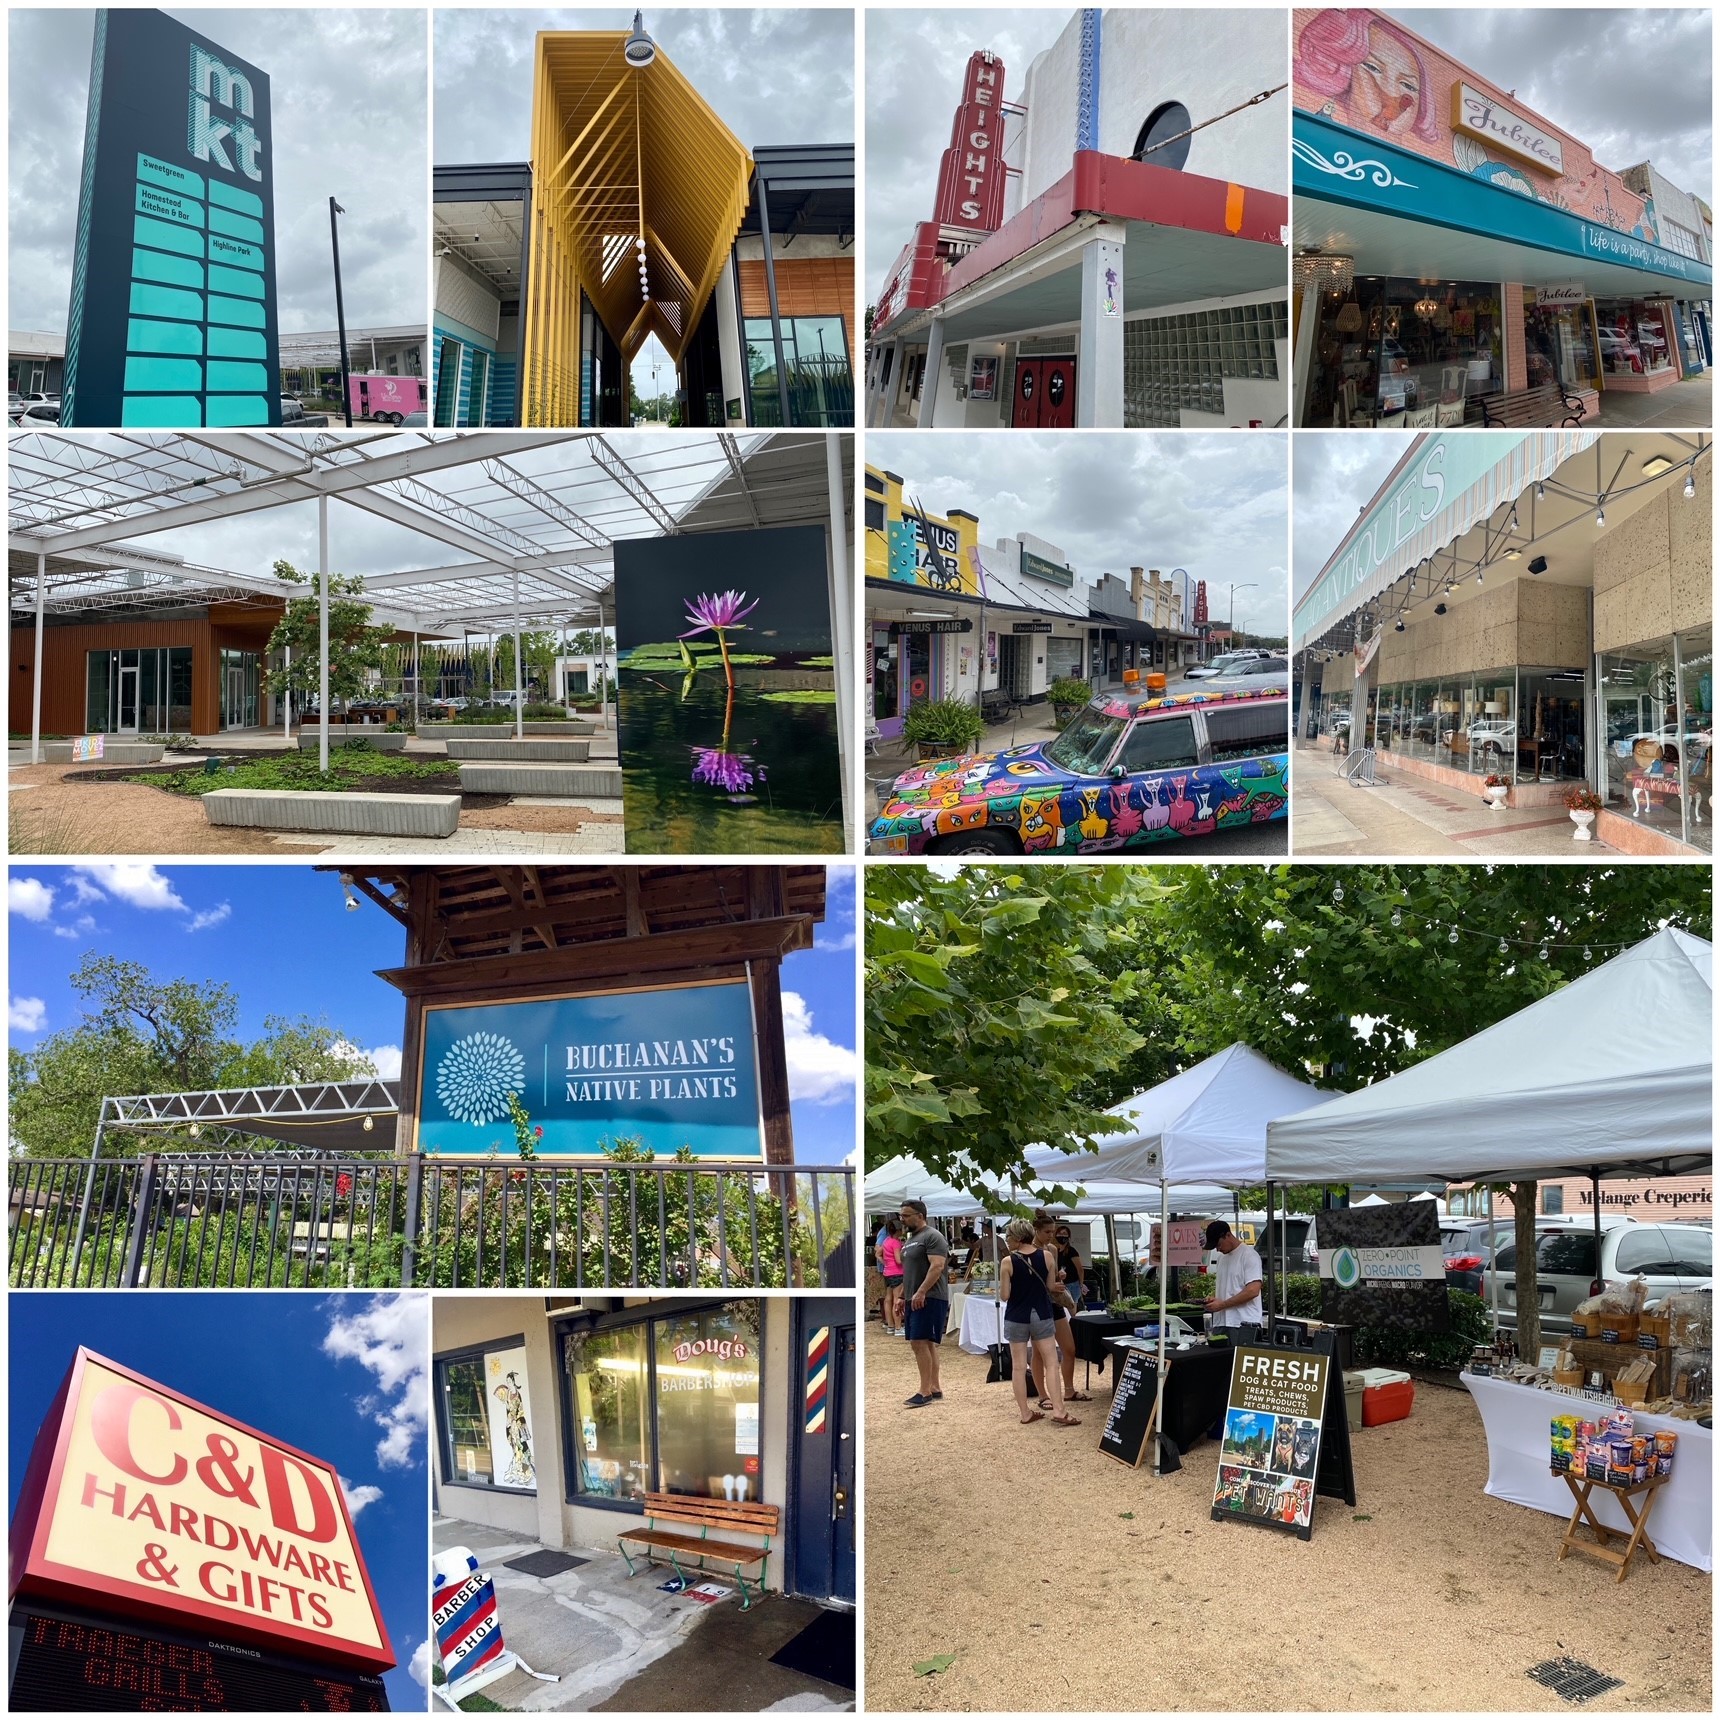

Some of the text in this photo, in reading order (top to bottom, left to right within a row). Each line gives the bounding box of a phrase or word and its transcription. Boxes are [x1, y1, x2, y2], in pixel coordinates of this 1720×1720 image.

[1464, 98, 1560, 164] Jubilee
[959, 67, 995, 220] HEIGHTS
[143, 159, 185, 179] Sweetgreen
[141, 189, 182, 207] Homestead
[141, 201, 170, 215] Kitchen
[178, 211, 189, 220] Bar
[213, 240, 251, 256] Highline Park
[1611, 239, 1618, 254] is
[1621, 243, 1629, 254] a
[1538, 287, 1581, 302] Jubilee
[1324, 444, 1445, 611] ANTIQUES
[899, 621, 961, 633] VENUS HAIR
[566, 1036, 735, 1070] BUCHANAN'S
[566, 1076, 737, 1102] NATIVE PLANTS
[1580, 1190, 1640, 1208] Mlange
[1364, 1264, 1422, 1277] ORGANICS
[672, 1334, 747, 1364] Doug's
[1242, 1355, 1320, 1382] FRESH
[661, 1371, 755, 1392] BARBERSHOP
[1240, 1375, 1259, 1385] DOG
[1271, 1379, 1288, 1388] CAT
[1291, 1381, 1318, 1392] FOOD
[1244, 1394, 1264, 1402] SPAW
[1272, 1405, 1308, 1416] PRODUCTS
[91, 1384, 338, 1543] C&D
[1222, 1481, 1248, 1503] PET
[80, 1472, 356, 1594] HARDWARE
[136, 1543, 333, 1629] & GIFTS
[433, 1575, 487, 1626] BARBER
[30, 1616, 213, 1675] TRAEGER
[455, 1617, 494, 1657] SHOP
[208, 1641, 261, 1658] DAKTRONICS
[84, 1657, 224, 1703] GRILLS
[359, 1675, 383, 1686] GALAXY
